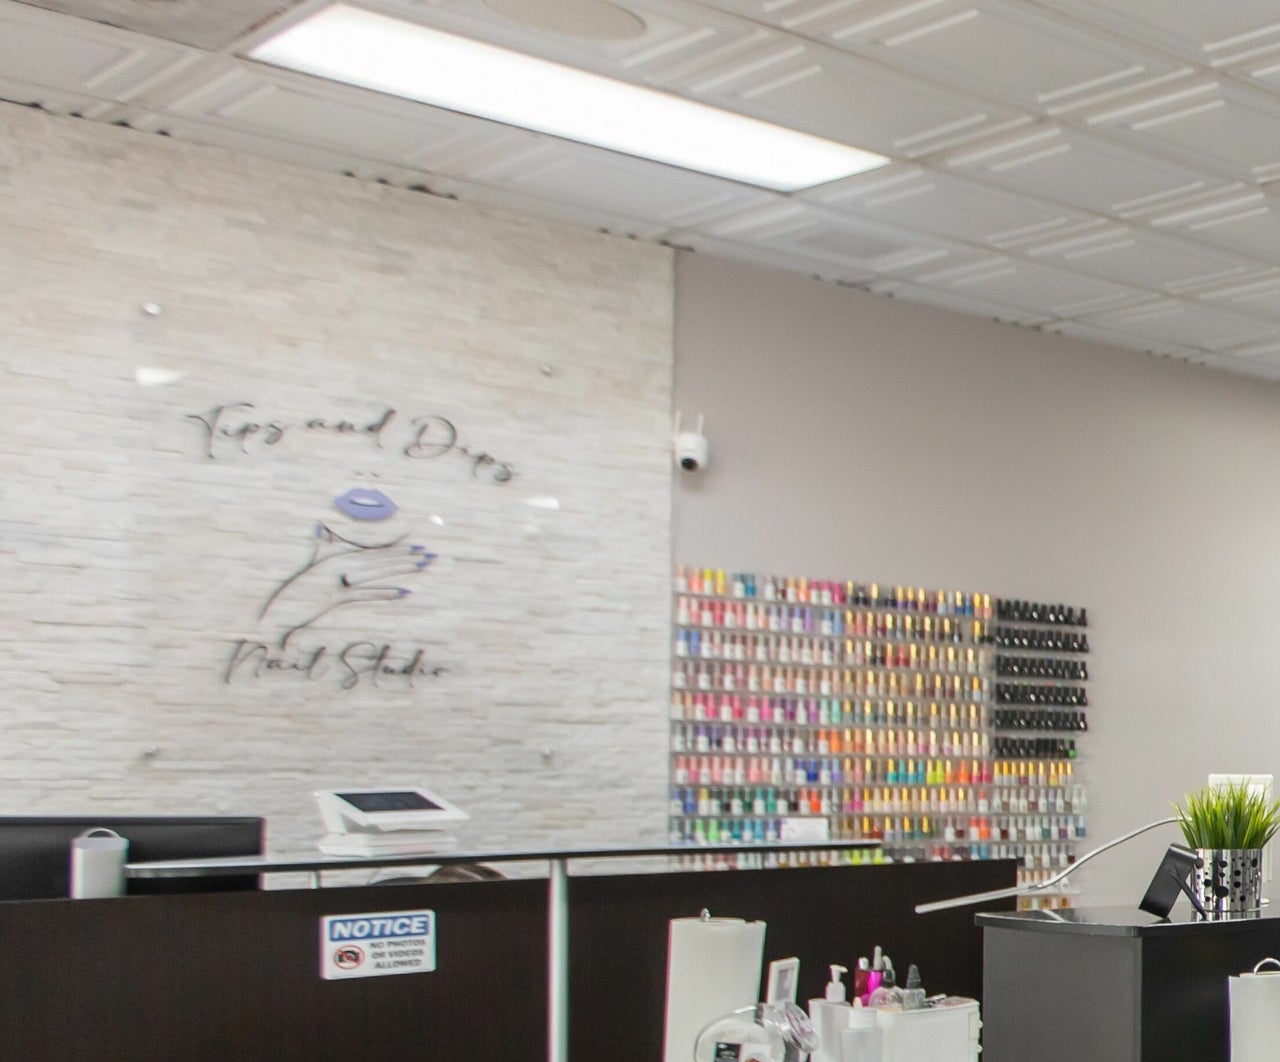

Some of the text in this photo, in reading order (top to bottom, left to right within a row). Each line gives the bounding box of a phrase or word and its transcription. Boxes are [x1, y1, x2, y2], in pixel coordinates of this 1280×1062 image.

[186, 403, 520, 482] Tips and Dips
[223, 637, 451, 690] Nail Studio
[332, 917, 428, 939] NOTICE
[370, 940, 426, 949] NO PHOTOS
[372, 949, 425, 959] OR VIDEOS
[375, 959, 422, 969] ALLOWED
